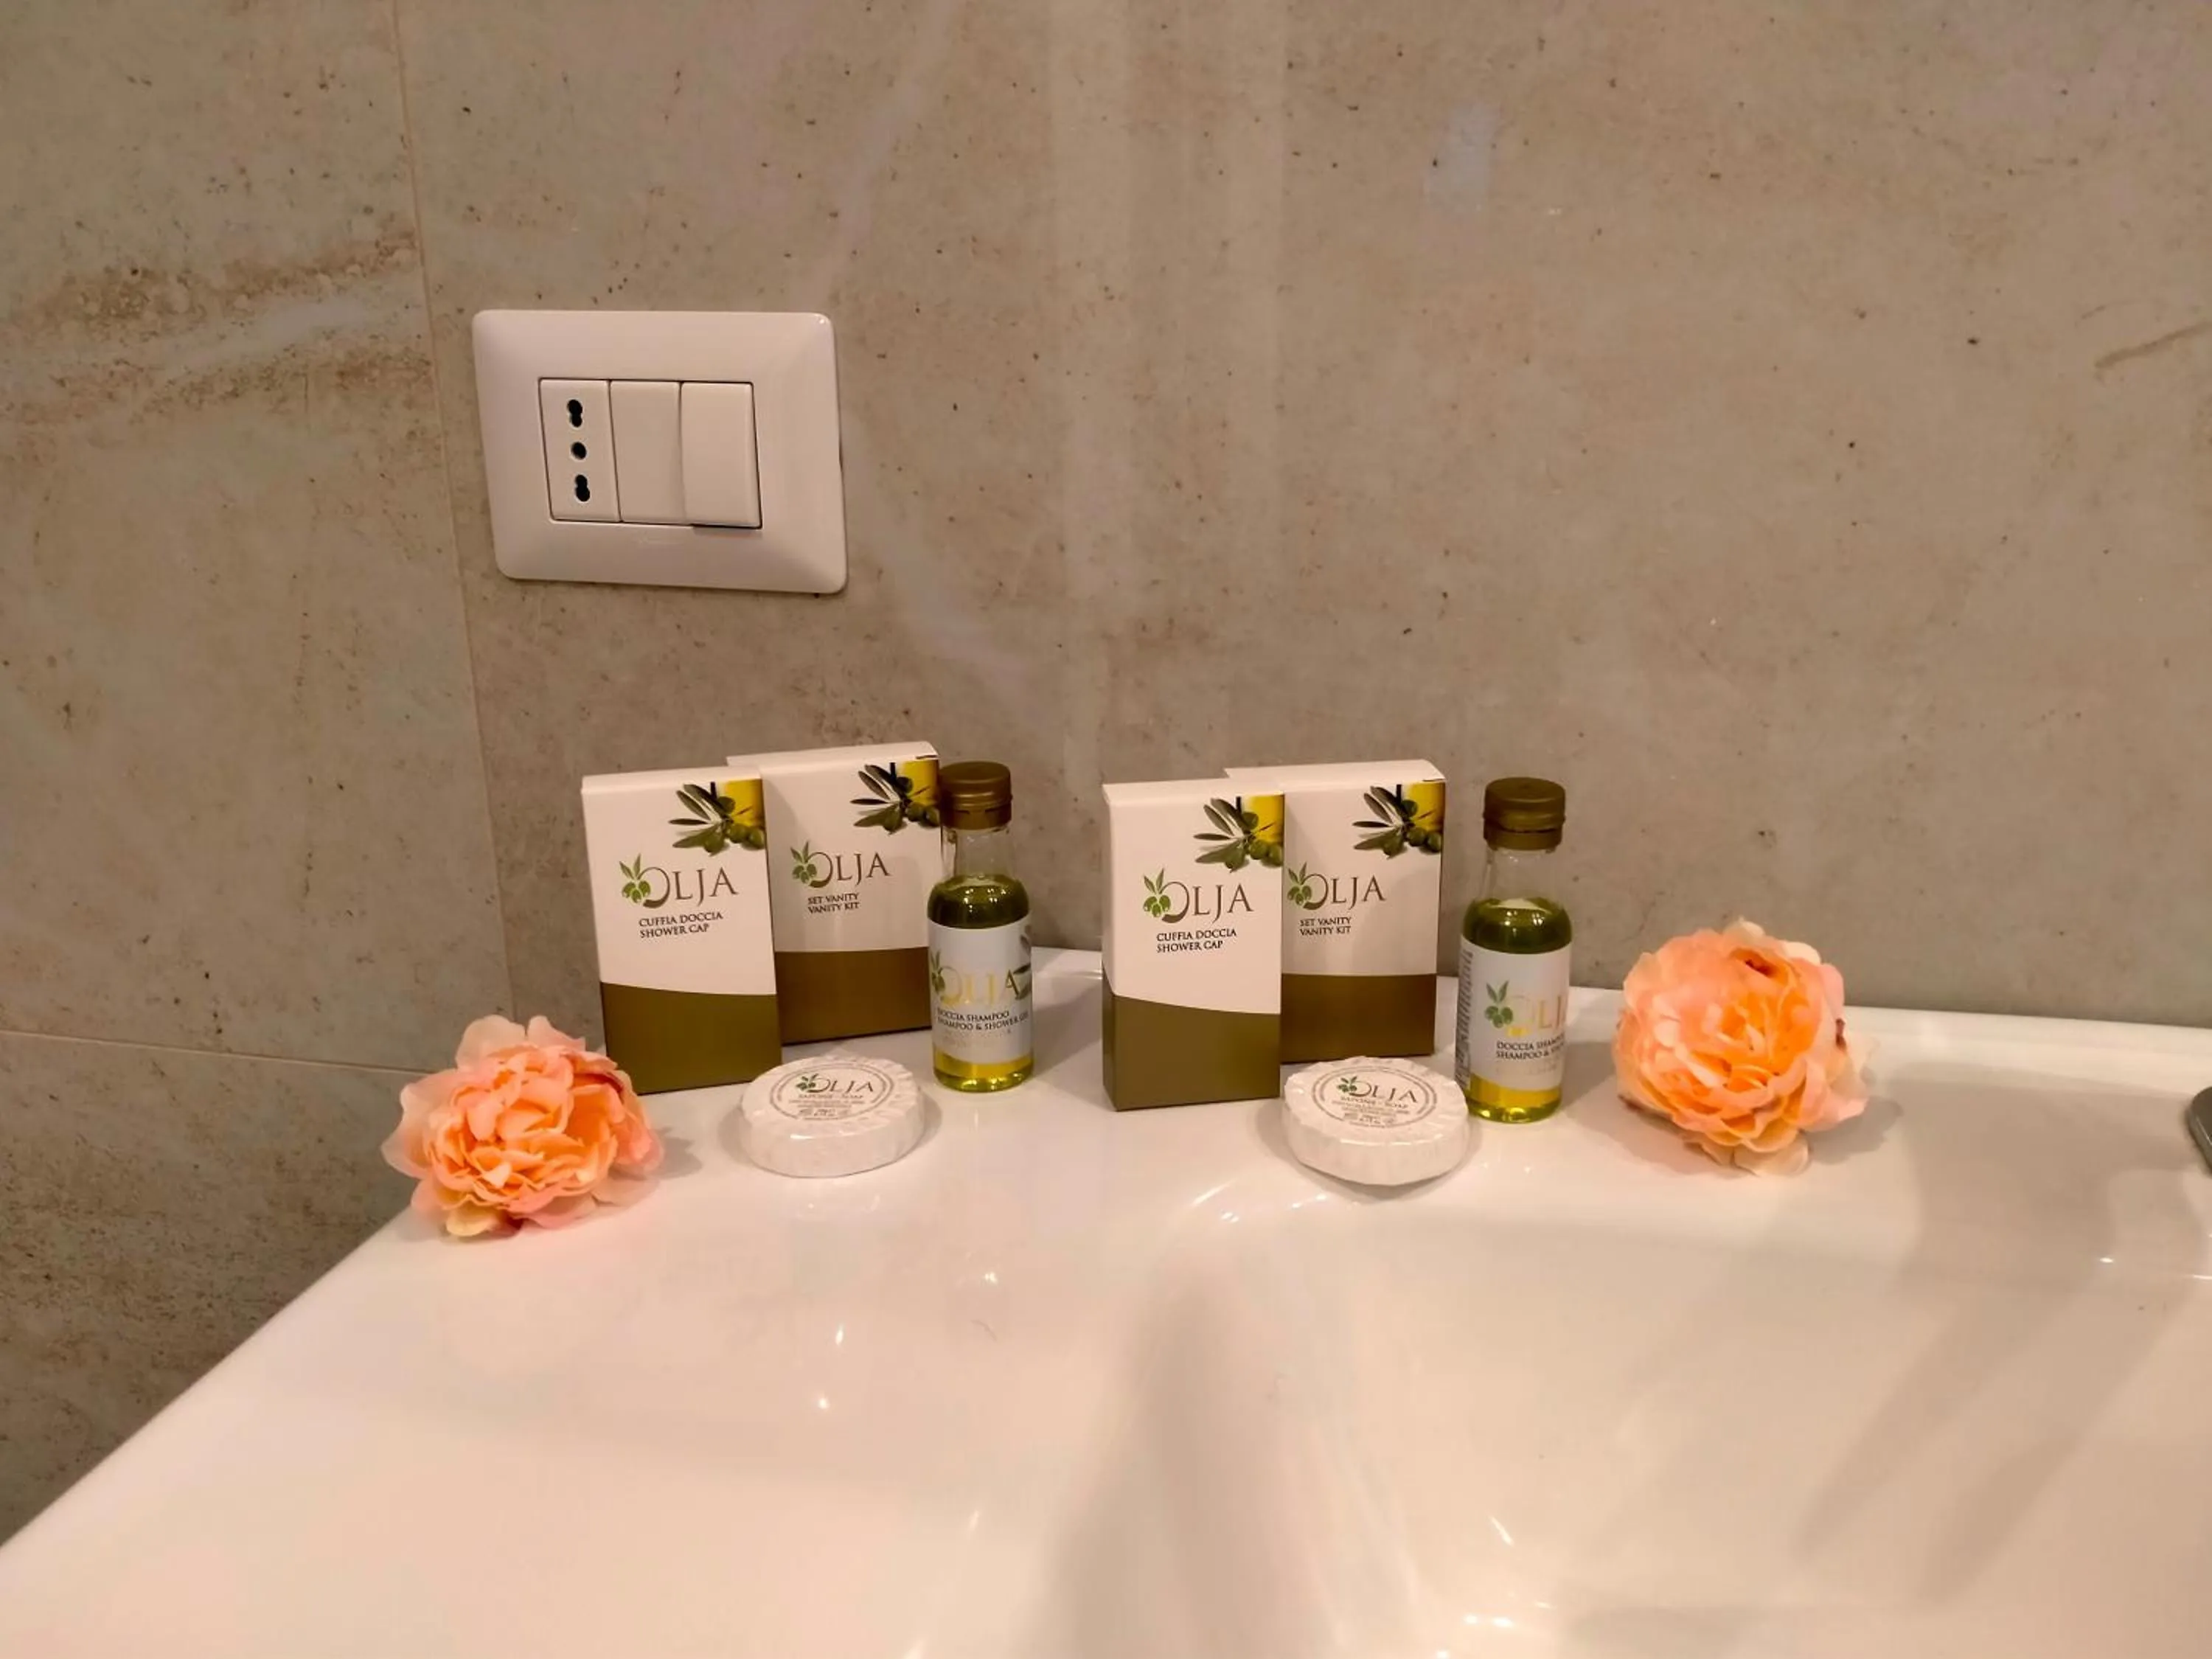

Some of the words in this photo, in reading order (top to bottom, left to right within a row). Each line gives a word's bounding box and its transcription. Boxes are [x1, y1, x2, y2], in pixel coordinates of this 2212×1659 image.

[807, 852, 892, 888] OLJA
[637, 866, 739, 909] OLJA
[1300, 873, 1387, 911] OLJA
[807, 896, 824, 905] SET
[825, 892, 860, 902] VANITY
[1159, 881, 1254, 924] OLJA
[807, 903, 843, 914] VANITY
[844, 901, 860, 911] KIT
[639, 915, 678, 927] CUFFIA
[679, 911, 723, 925] DOCCIA
[1299, 918, 1316, 927] SET
[1317, 917, 1352, 926] VANITY
[639, 925, 687, 939] SHOWER
[688, 923, 710, 933] CAP
[1156, 931, 1194, 942] CUFFIA
[1195, 928, 1237, 940] DOCCIA
[1299, 926, 1334, 936] VANITY
[1335, 925, 1352, 935] KIT
[1156, 942, 1203, 953] SHOWER
[1203, 939, 1224, 950] CAP
[1496, 1040, 1534, 1051] DOCCIA
[1495, 1049, 1543, 1060] SHAMPOO
[807, 1077, 874, 1093] OLJA
[1349, 1079, 1418, 1104] OLJA
